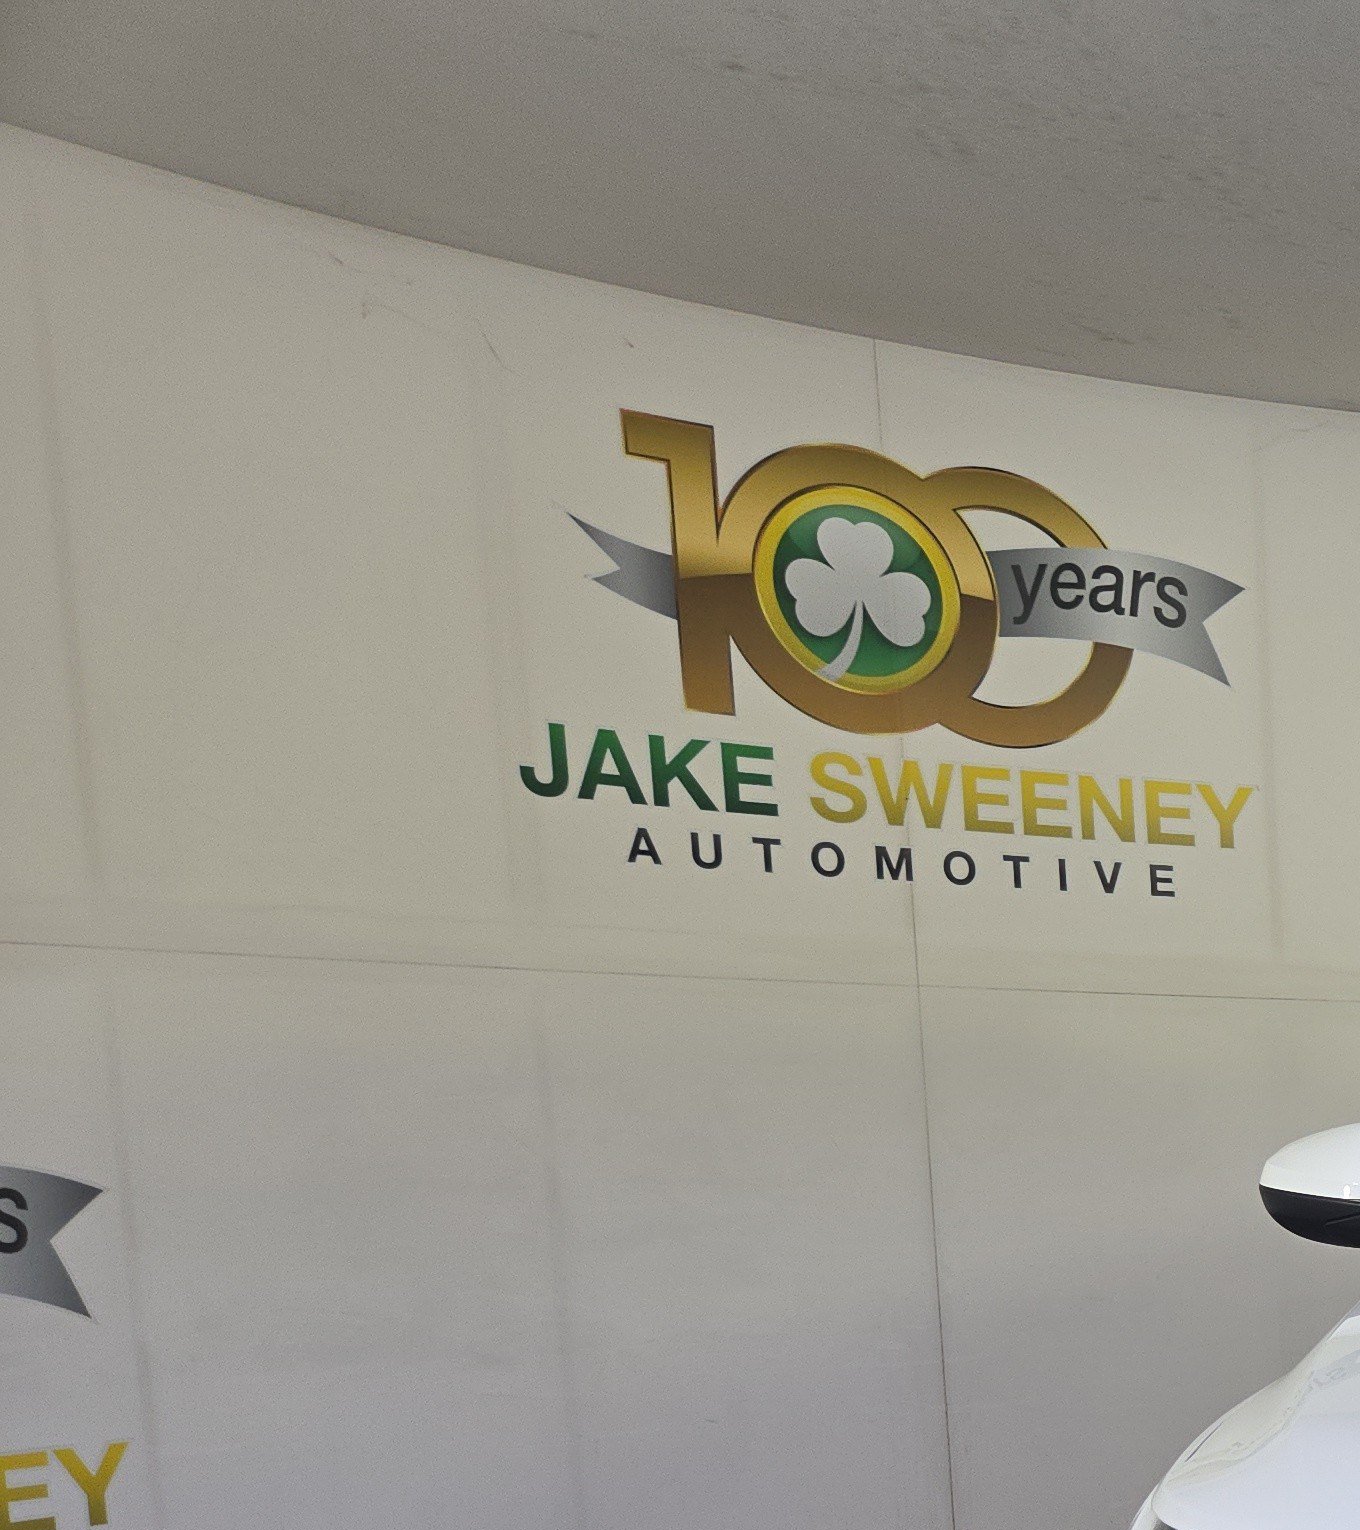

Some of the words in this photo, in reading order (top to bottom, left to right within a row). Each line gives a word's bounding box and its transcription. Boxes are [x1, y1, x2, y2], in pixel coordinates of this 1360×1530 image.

[1010, 561, 1188, 629] years
[519, 722, 779, 817] JAKE
[809, 752, 1256, 849] SWEENEY
[627, 827, 1177, 898] AUTOMOTIVE
